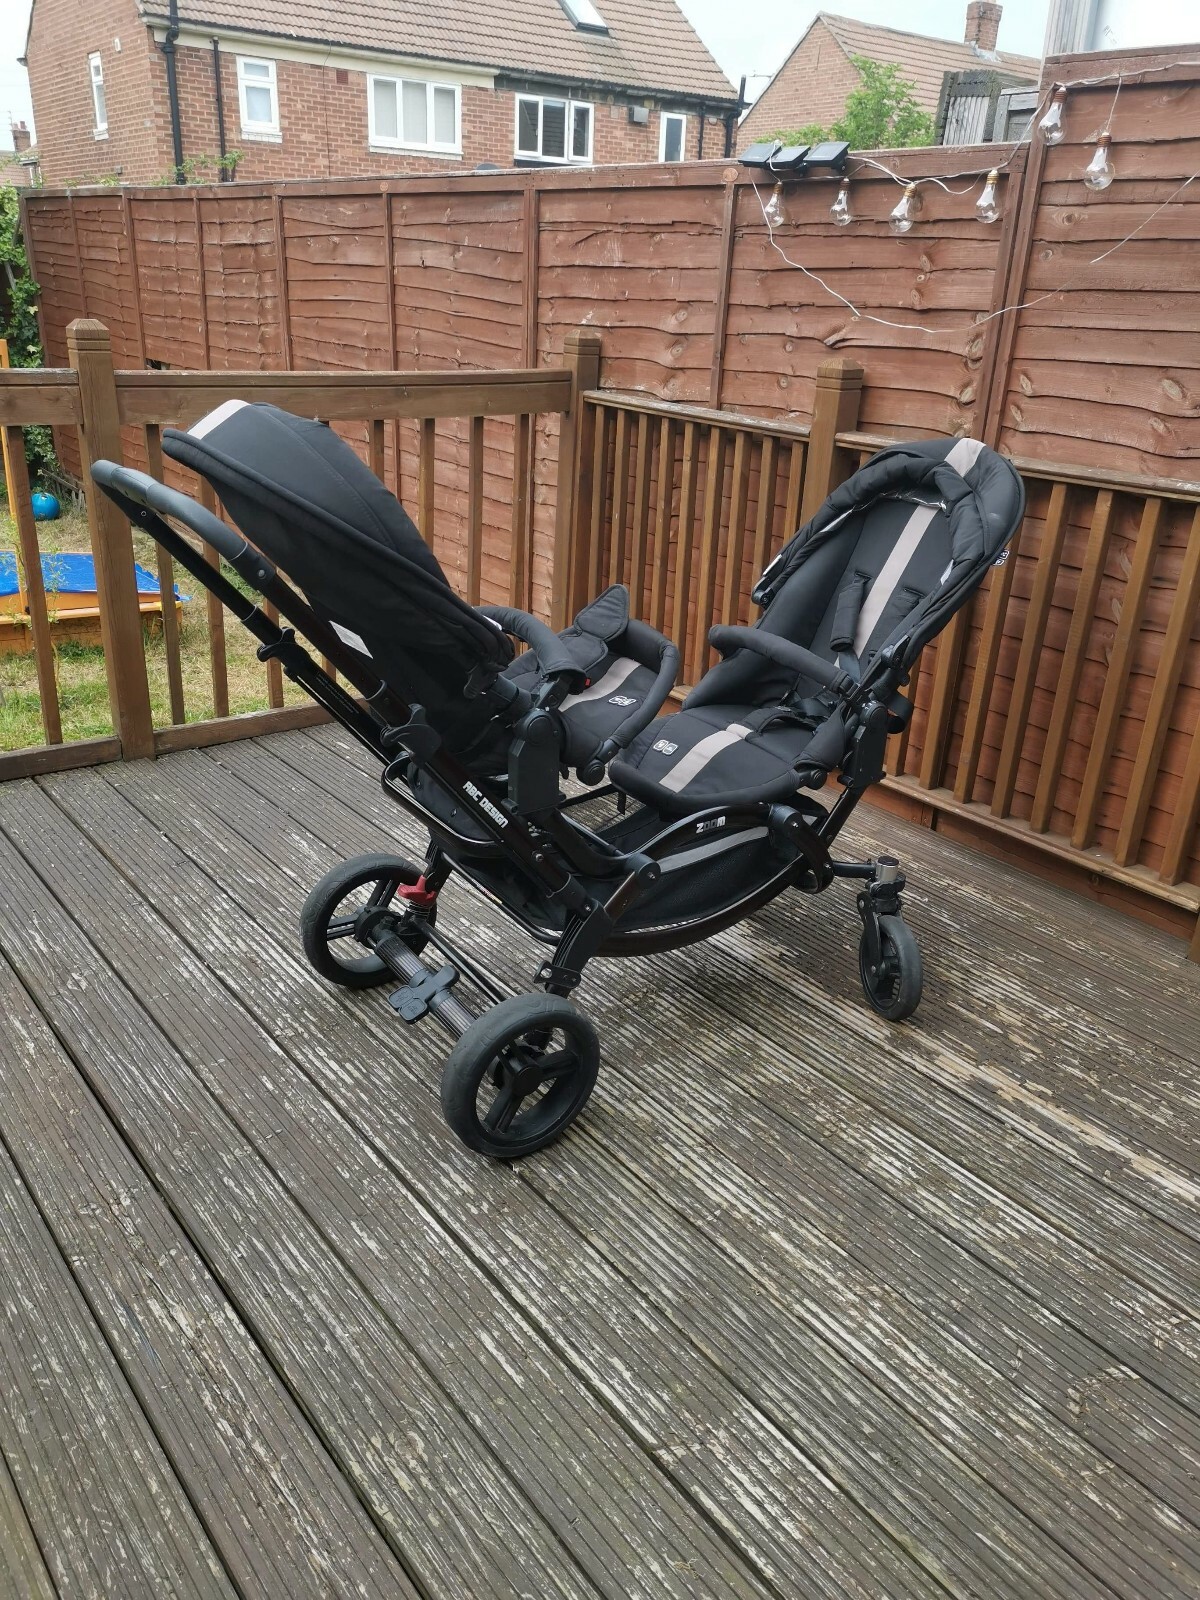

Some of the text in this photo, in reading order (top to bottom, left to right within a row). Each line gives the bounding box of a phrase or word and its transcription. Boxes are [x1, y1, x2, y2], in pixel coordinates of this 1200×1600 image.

[462, 780, 509, 829] ABC DESIGN
[695, 815, 726, 834] ZOOM
